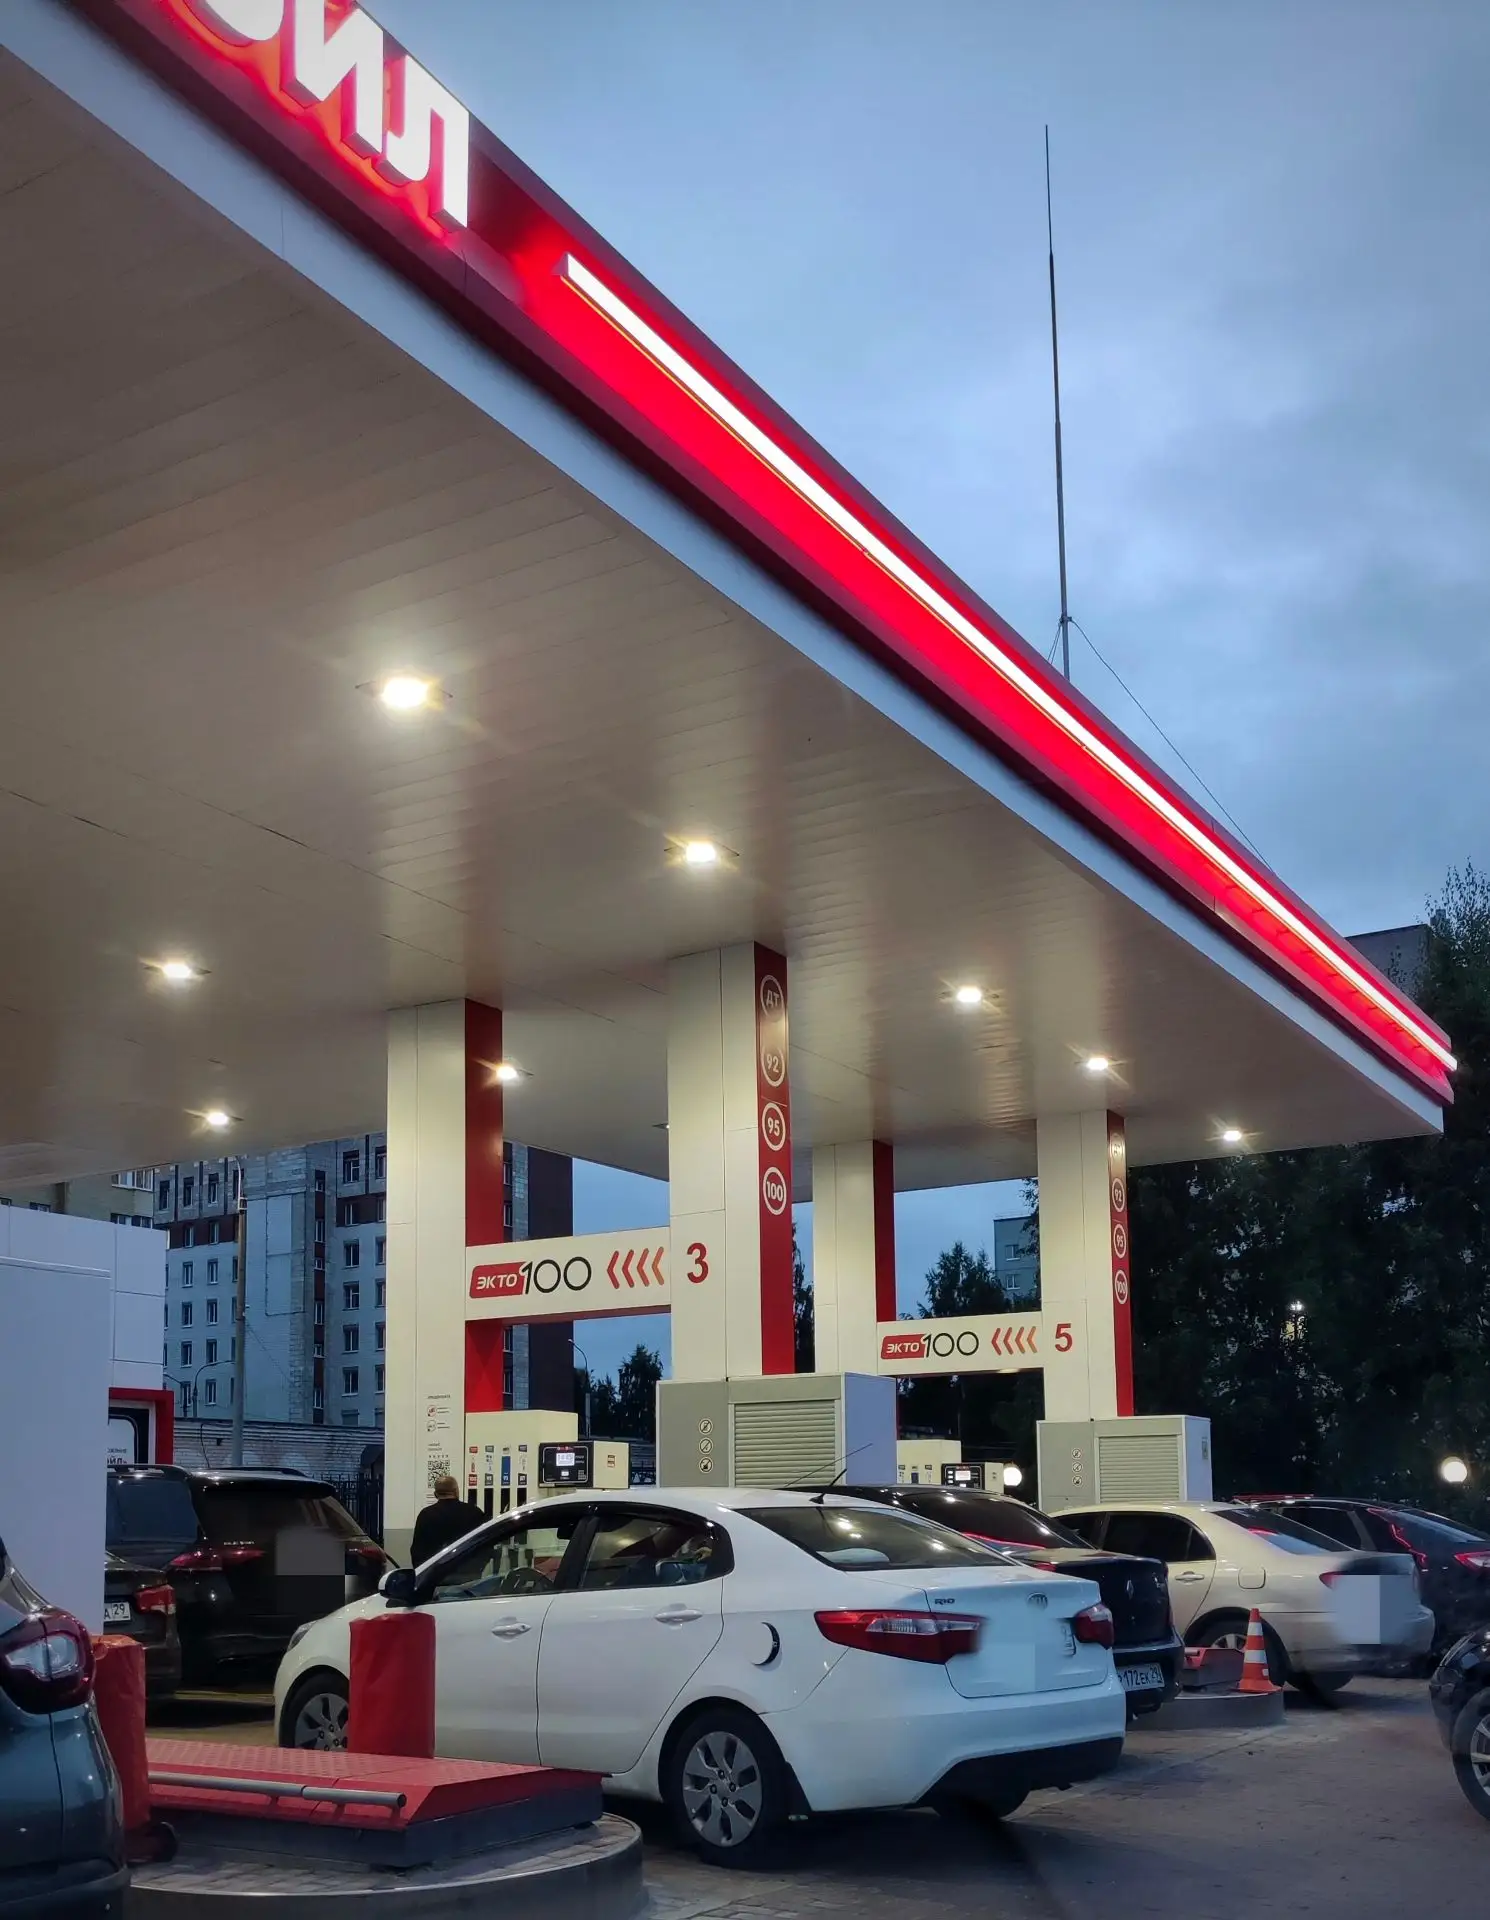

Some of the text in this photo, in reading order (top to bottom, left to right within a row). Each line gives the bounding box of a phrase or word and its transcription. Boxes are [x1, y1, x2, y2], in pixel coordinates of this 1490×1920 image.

[766, 1053, 780, 1073] 92
[767, 1117, 781, 1137] 95
[766, 1180, 784, 1202] 100
[1114, 1188, 1123, 1202] 92
[1116, 1234, 1125, 1248] 95
[686, 1242, 709, 1284] 3
[1116, 1280, 1127, 1294] 100
[1054, 1322, 1073, 1353] 5
[112, 1603, 125, 1615] 29
